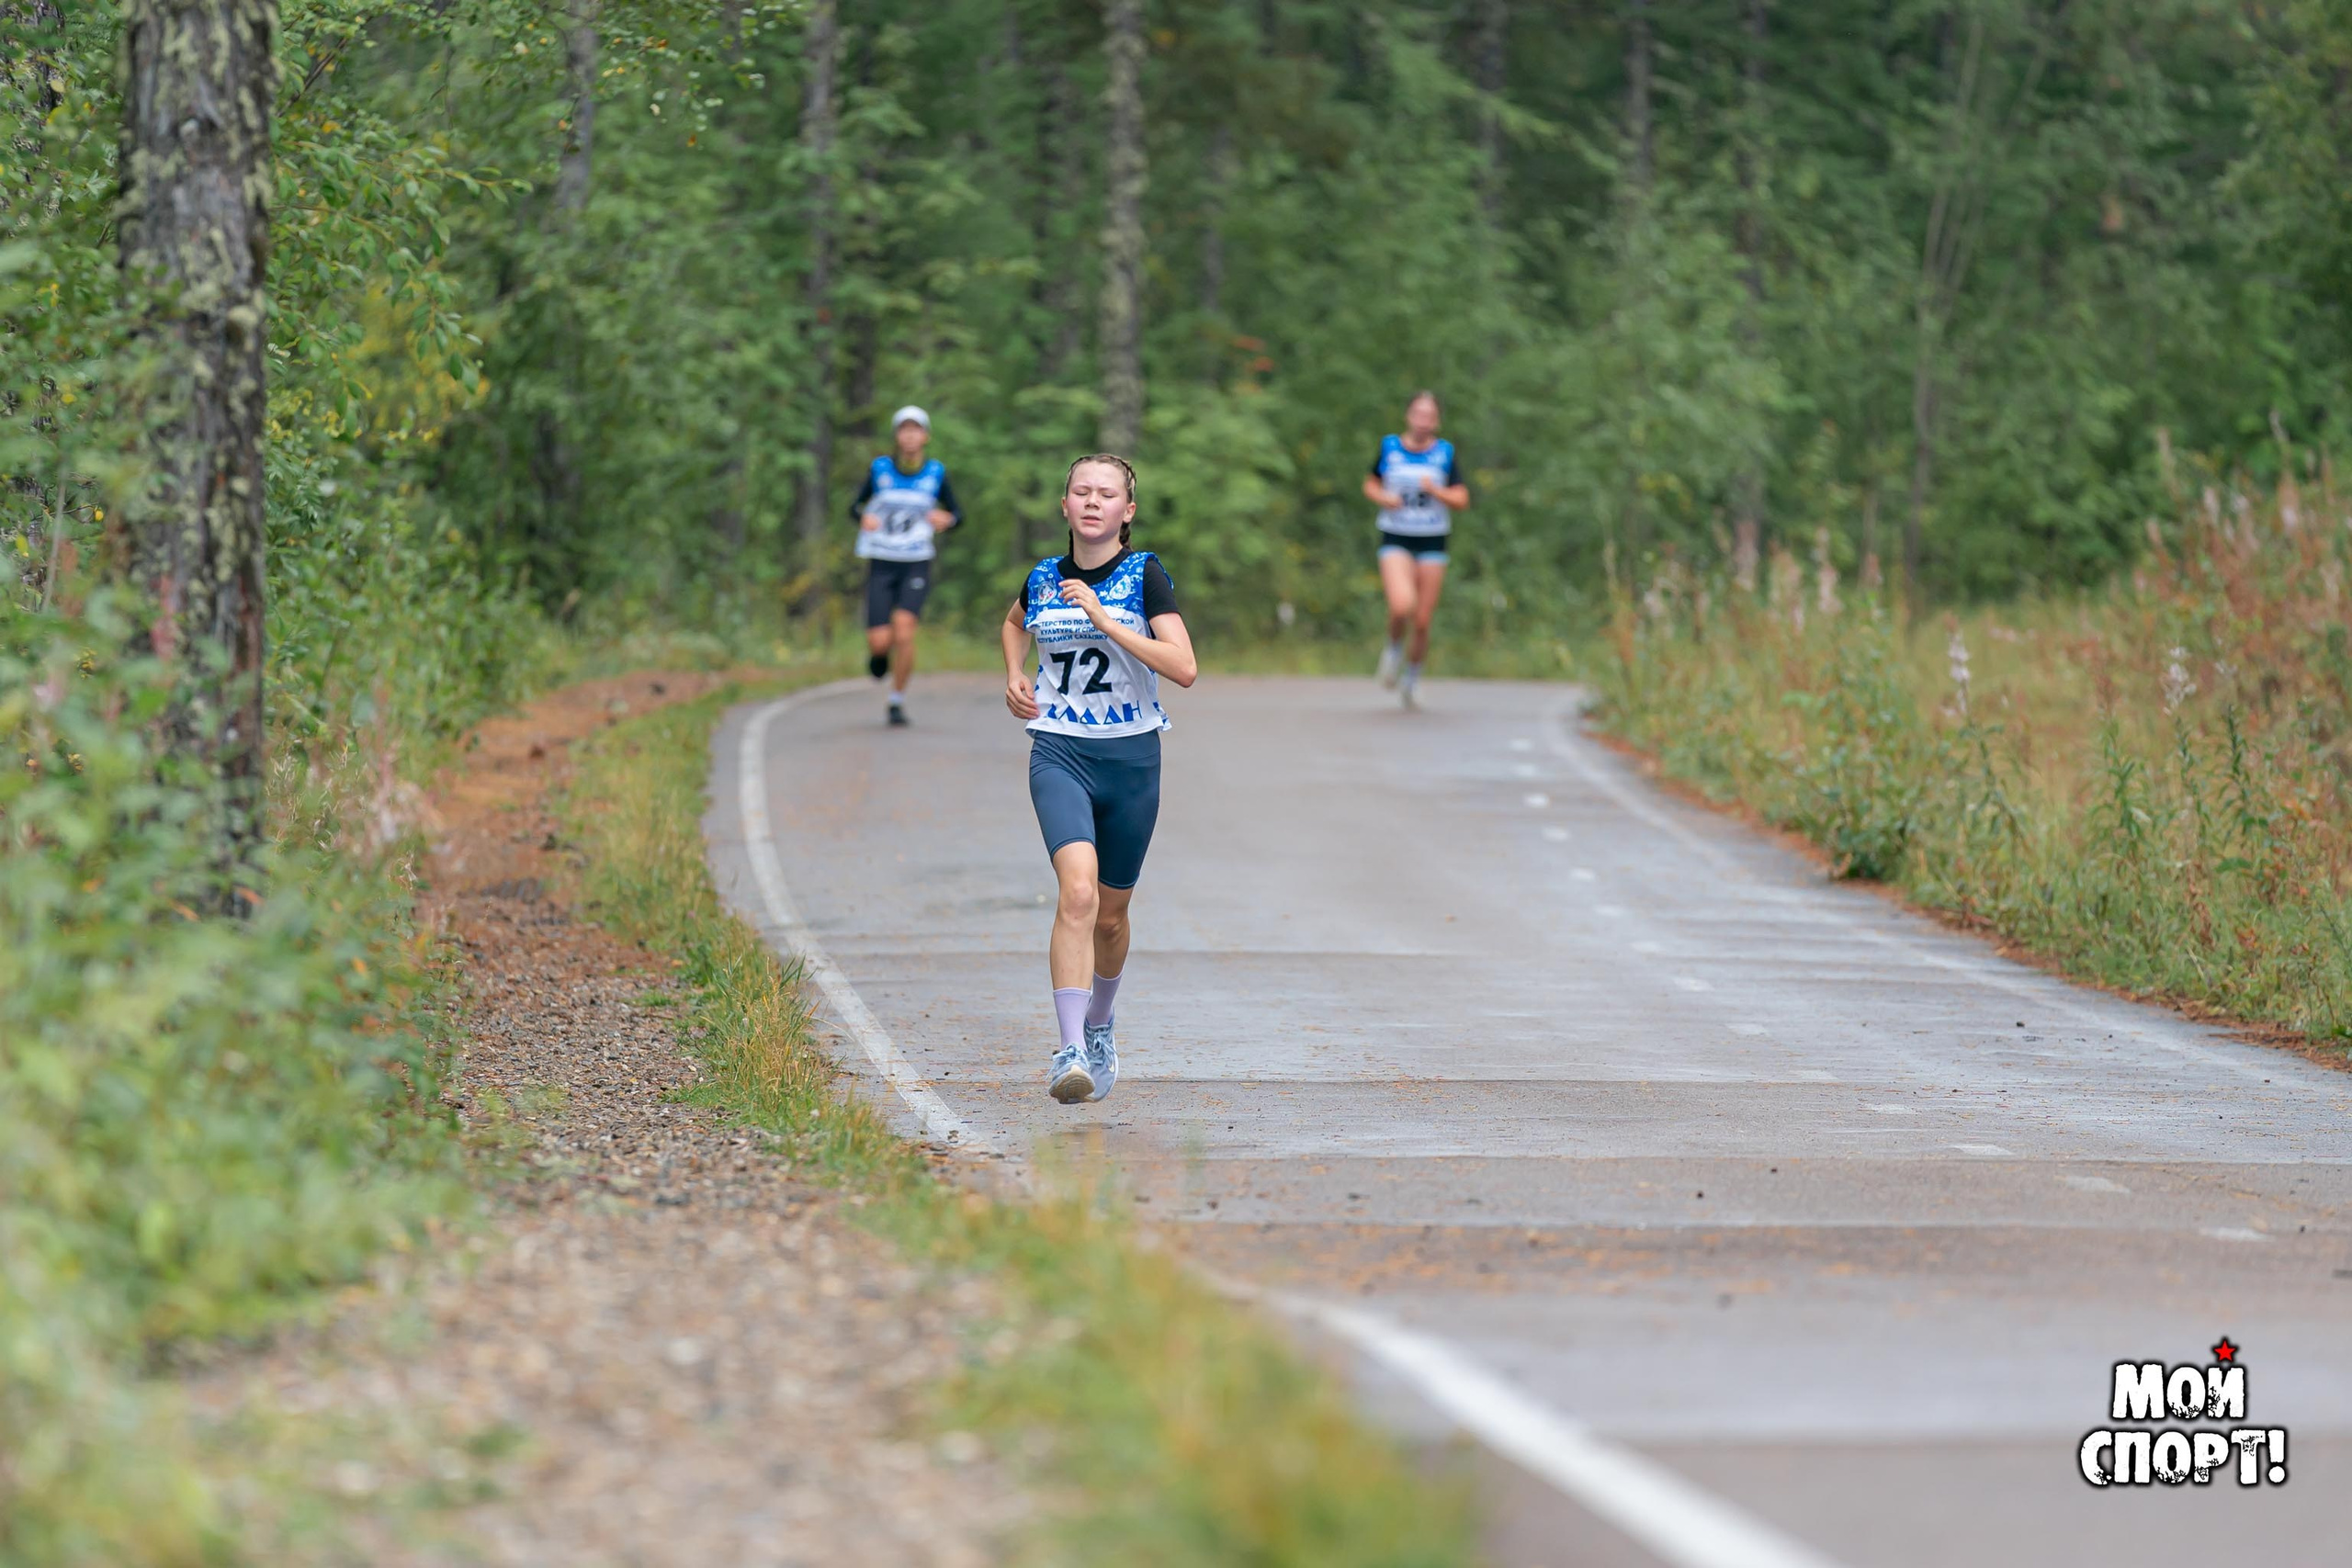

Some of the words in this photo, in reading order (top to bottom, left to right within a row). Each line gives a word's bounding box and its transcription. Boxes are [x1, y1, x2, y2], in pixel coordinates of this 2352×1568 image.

[1040, 626, 1073, 635] КУЛЬТУРЕ
[1036, 634, 1073, 643] СПУБЛИКИ
[1049, 647, 1113, 695] 72
